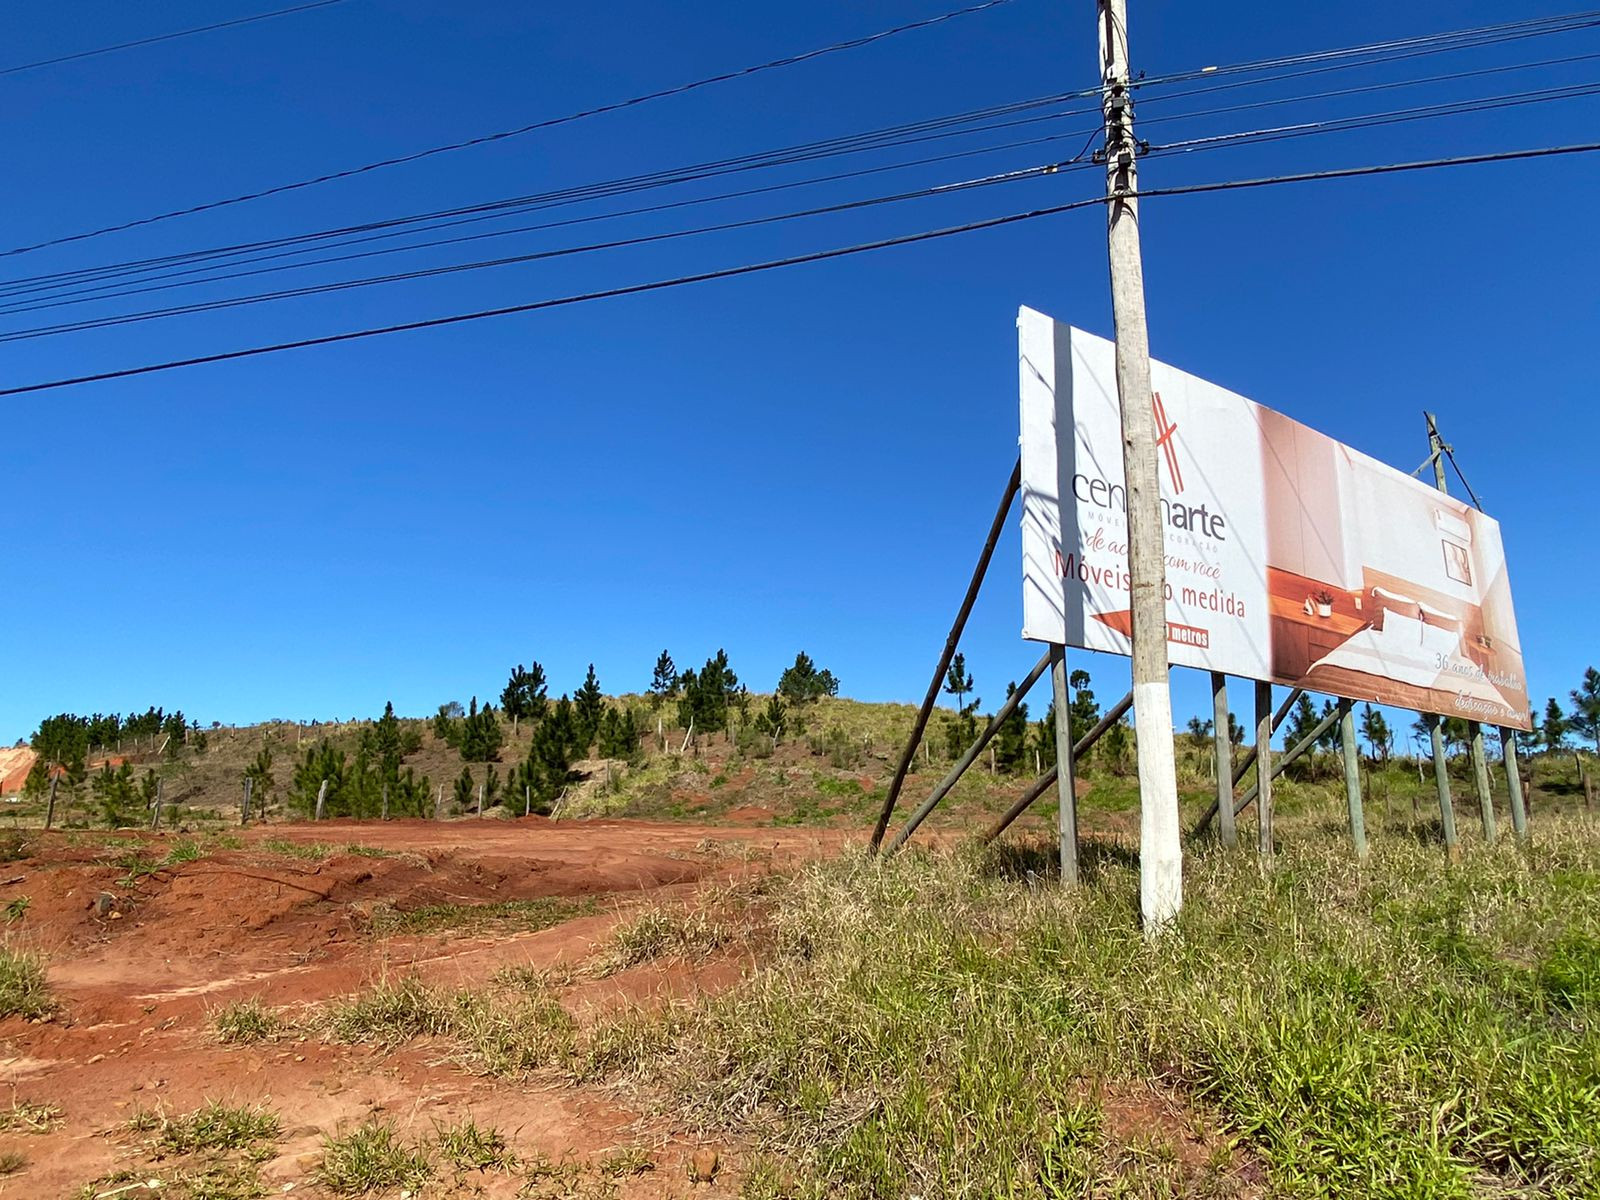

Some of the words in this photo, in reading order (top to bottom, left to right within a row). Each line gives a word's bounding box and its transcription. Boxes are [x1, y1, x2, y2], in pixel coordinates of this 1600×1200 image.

[1088, 511, 1126, 528] MÓVEI
[1086, 527, 1106, 552] de
[1192, 560, 1221, 580] você
[1055, 549, 1131, 592] Móveis
[1182, 586, 1246, 619] medida
[1171, 626, 1208, 645] metros
[1435, 652, 1449, 671] 36
[1451, 663, 1473, 678] anos
